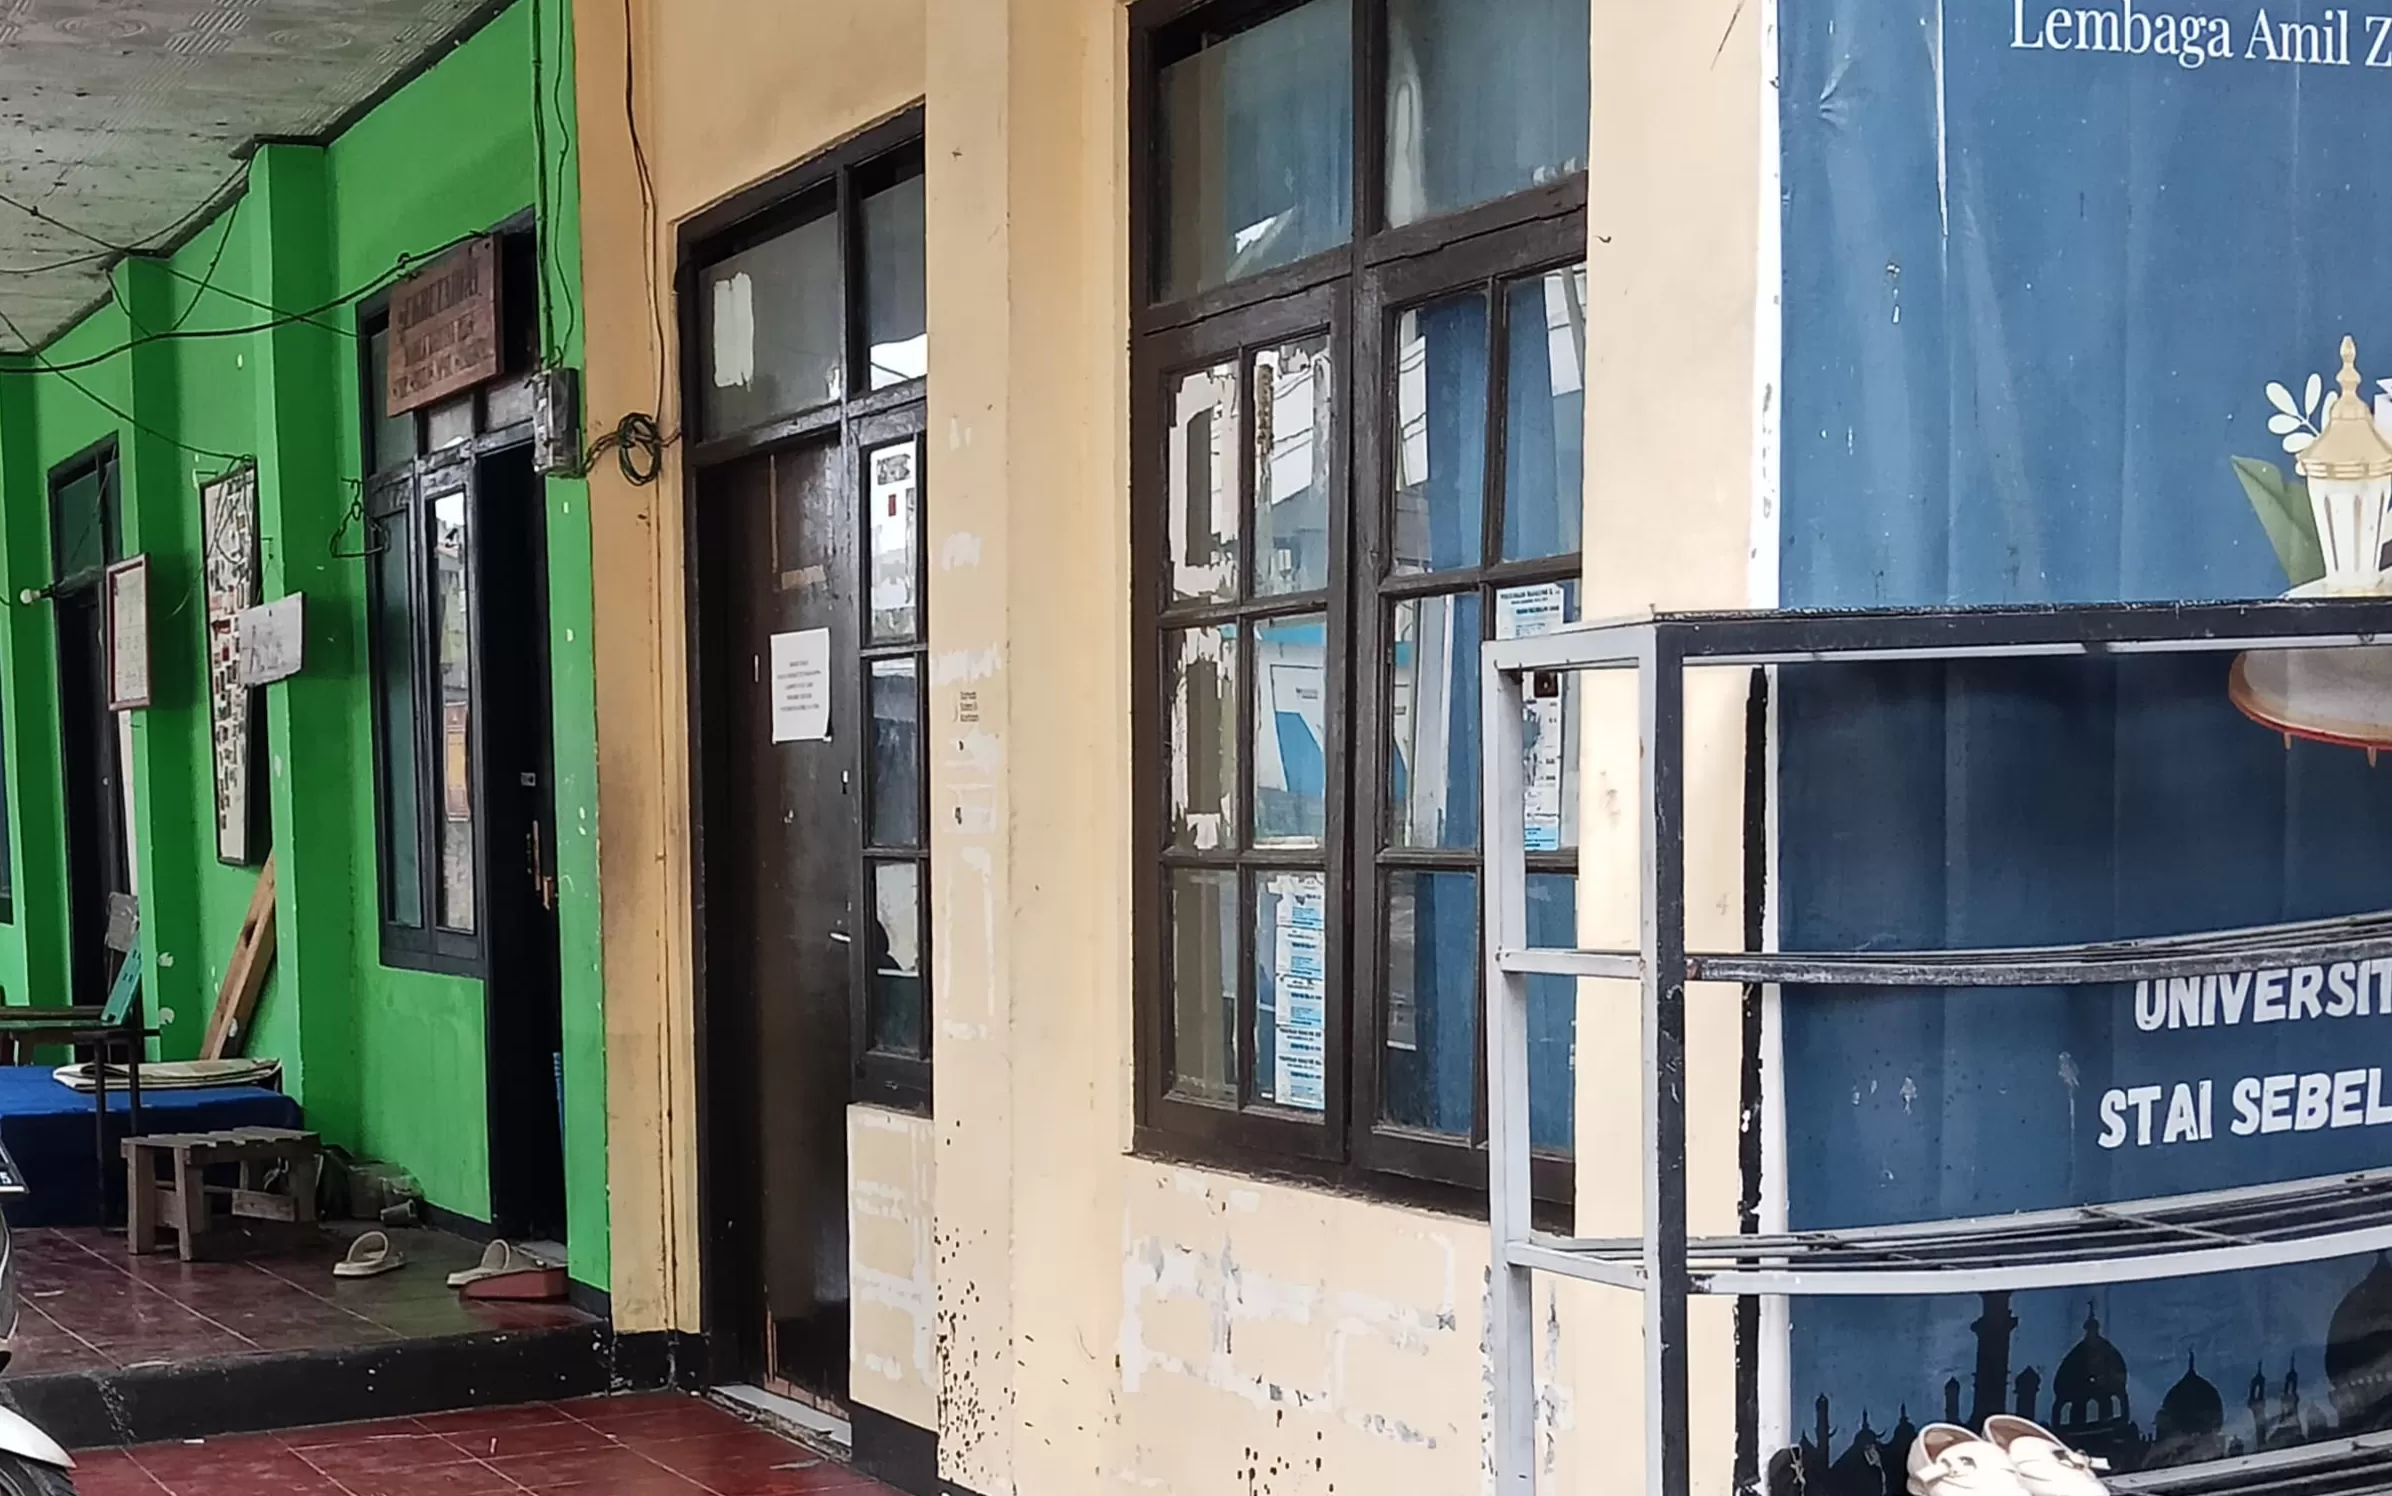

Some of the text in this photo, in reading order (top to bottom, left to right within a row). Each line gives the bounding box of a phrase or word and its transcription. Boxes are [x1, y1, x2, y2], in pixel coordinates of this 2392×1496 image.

[2010, 0, 2234, 69] Lembaga
[2243, 8, 2350, 65] Amil
[2098, 1068, 2392, 1148] STAI SEBEL
